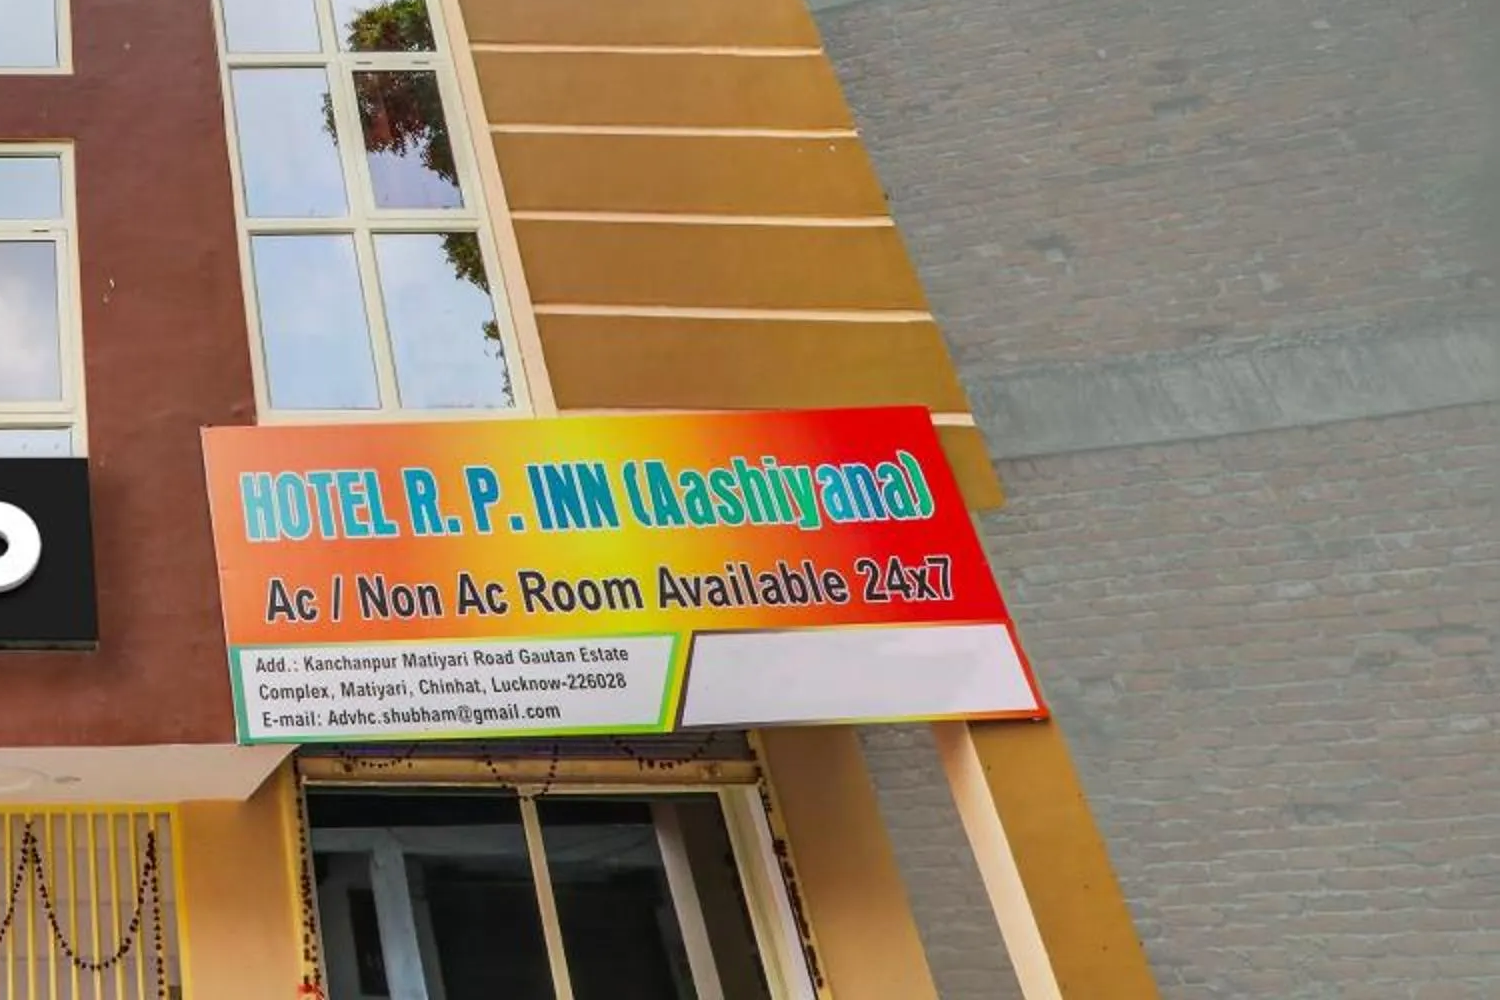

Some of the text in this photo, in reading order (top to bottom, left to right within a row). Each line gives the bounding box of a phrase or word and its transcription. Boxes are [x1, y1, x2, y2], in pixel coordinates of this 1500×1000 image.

[240, 449, 936, 542] HOTEL R. P. INN (Aashiyana)
[266, 554, 954, 623] Ac / Non Ac Room Available 24x7
[303, 655, 398, 674] Kanchanpur
[402, 651, 469, 670] Matiyari
[473, 649, 515, 666] Road
[518, 648, 576, 665] Gautan
[579, 646, 629, 663] Estate
[258, 671, 627, 703] Complex, Matiyari, Chinhat, Lucknow-226028
[261, 710, 323, 728] E-mail:
